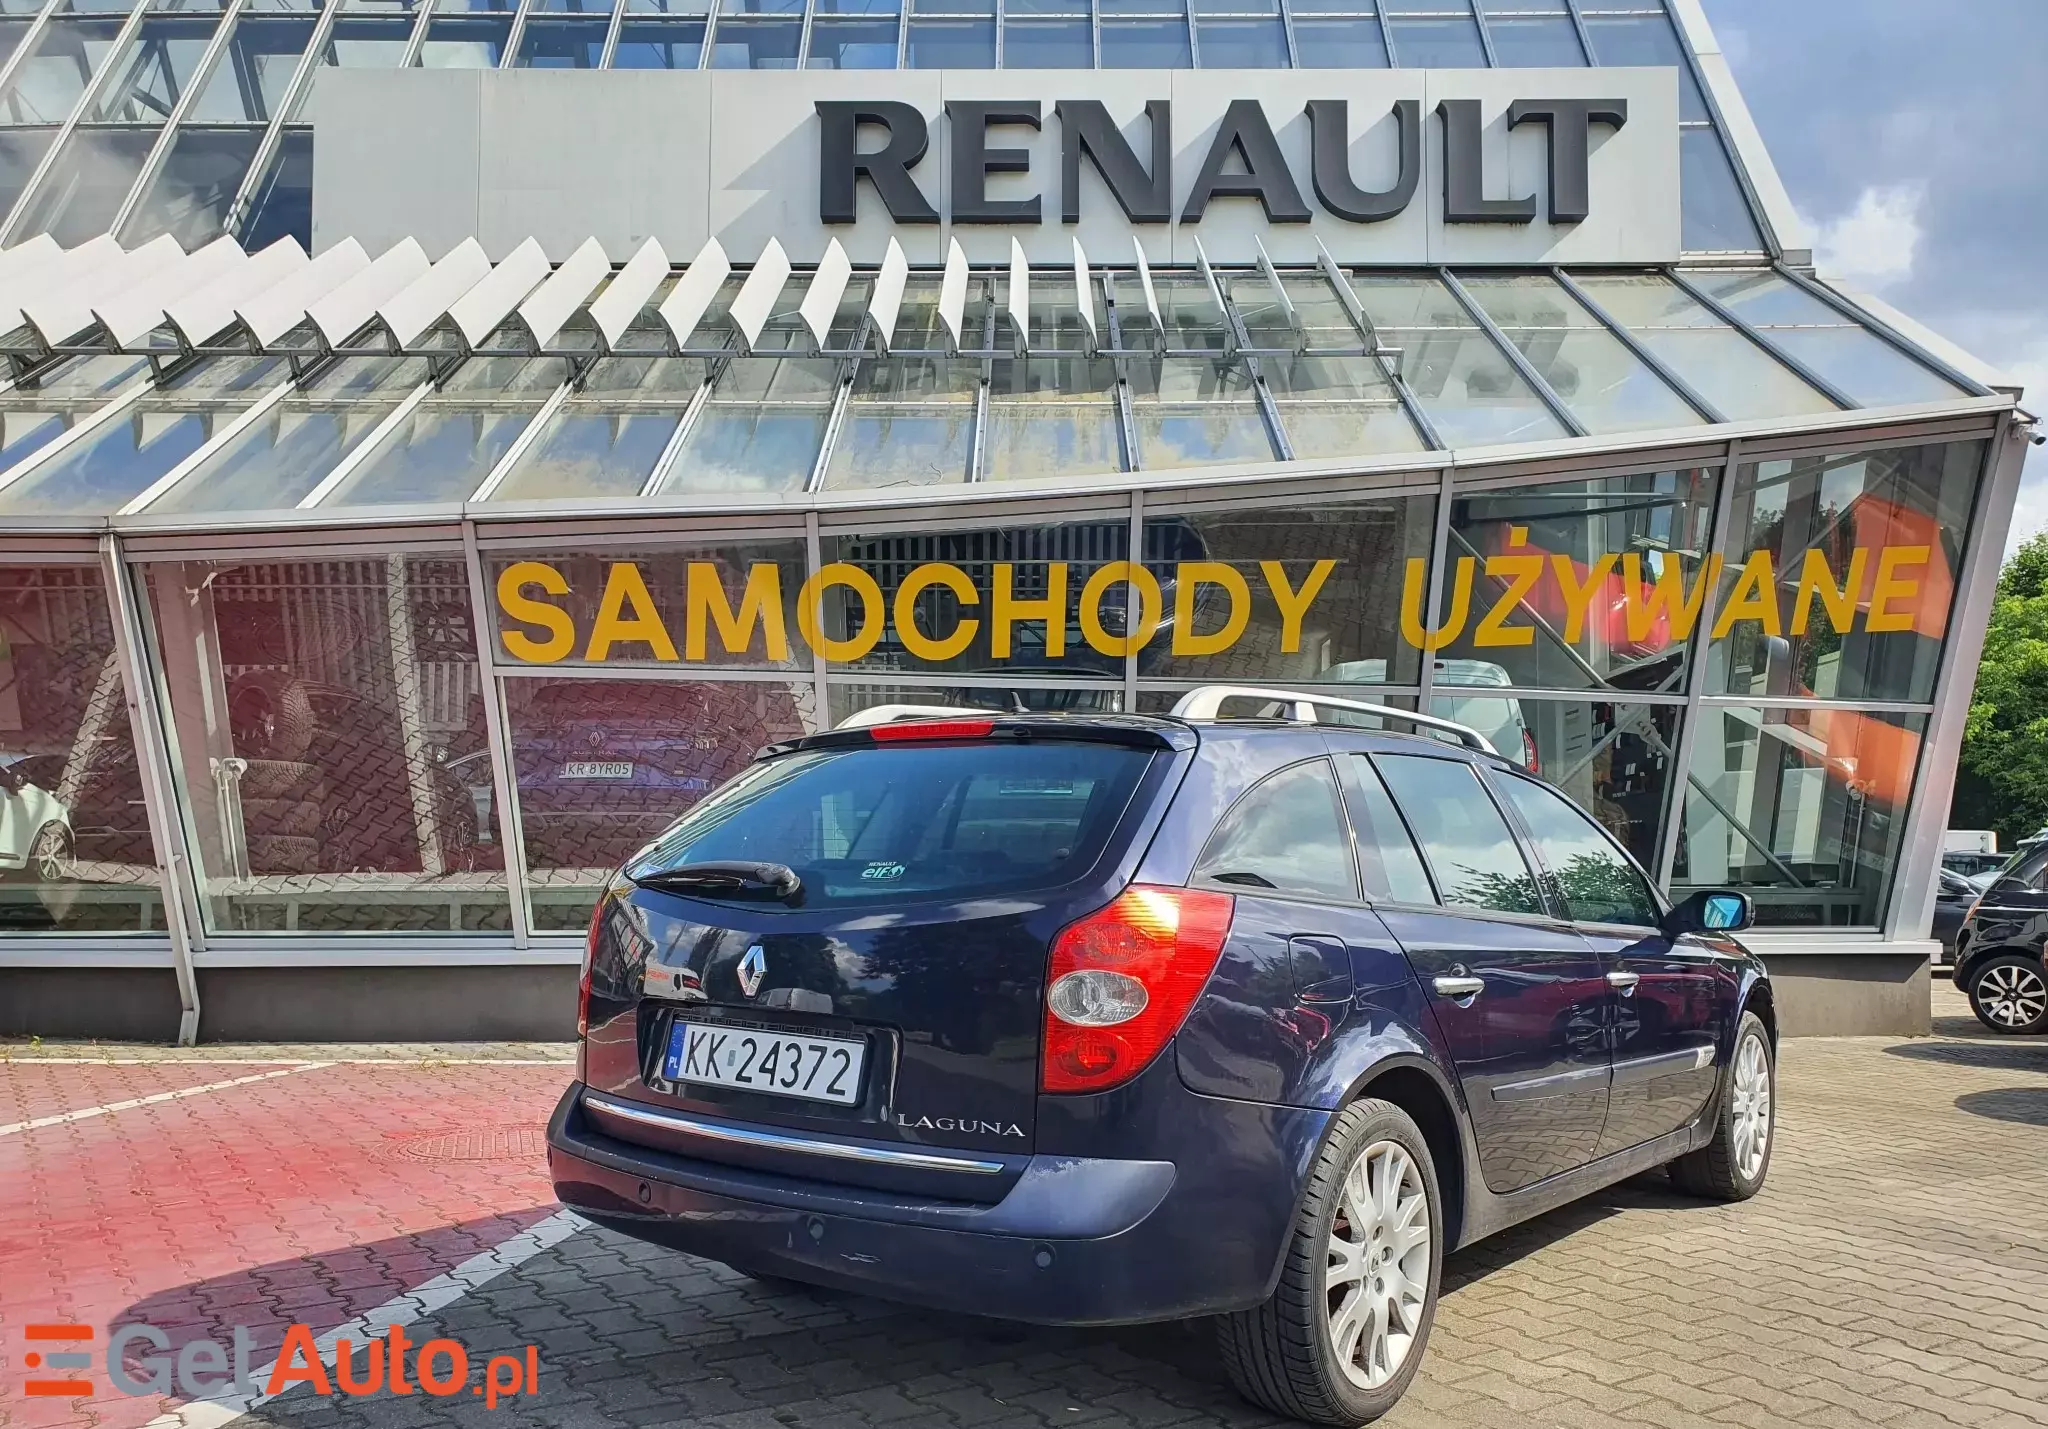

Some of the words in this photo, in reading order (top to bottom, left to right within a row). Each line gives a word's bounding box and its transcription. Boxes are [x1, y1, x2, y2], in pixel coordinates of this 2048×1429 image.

[815, 99, 1627, 225] RENAULT
[497, 560, 1337, 663] SAMOCHODY
[1401, 527, 1930, 651] UŻYWANE
[567, 763, 585, 775] KR
[668, 1056, 679, 1069] PL
[685, 1031, 728, 1079] KK
[735, 1037, 851, 1097] 24372
[897, 1113, 1026, 1137] LAGUNA
